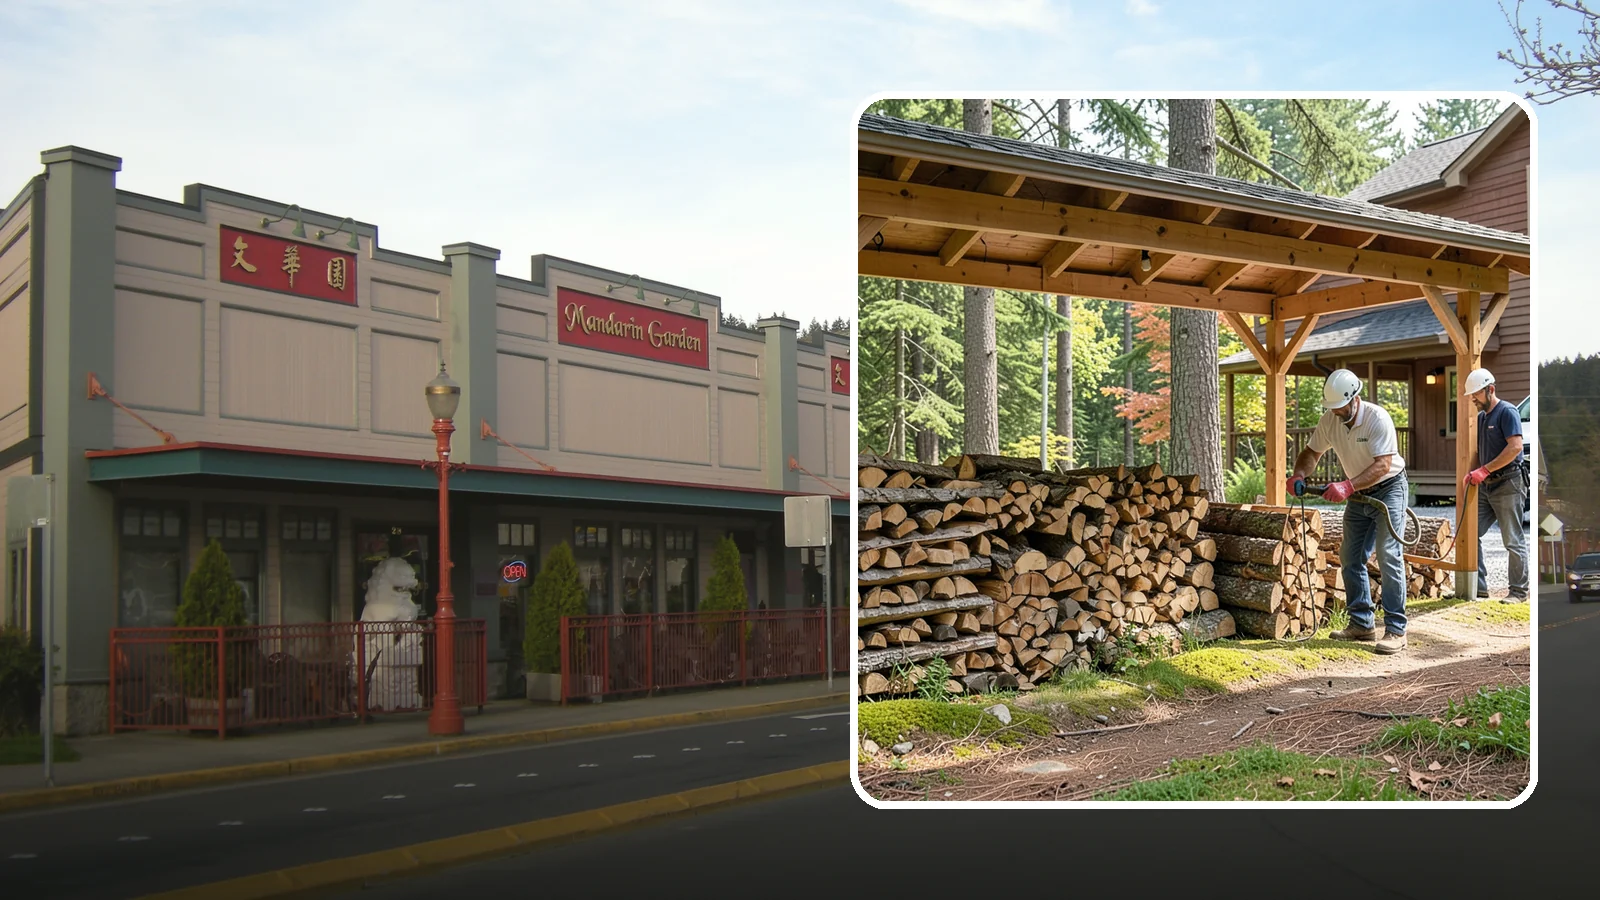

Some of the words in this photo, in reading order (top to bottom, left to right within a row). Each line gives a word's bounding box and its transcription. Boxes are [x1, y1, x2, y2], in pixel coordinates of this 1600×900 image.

[230, 235, 346, 291] 文華園
[564, 302, 644, 341] Mandarin
[647, 320, 701, 352] Garden
[503, 565, 526, 578] OPEN
